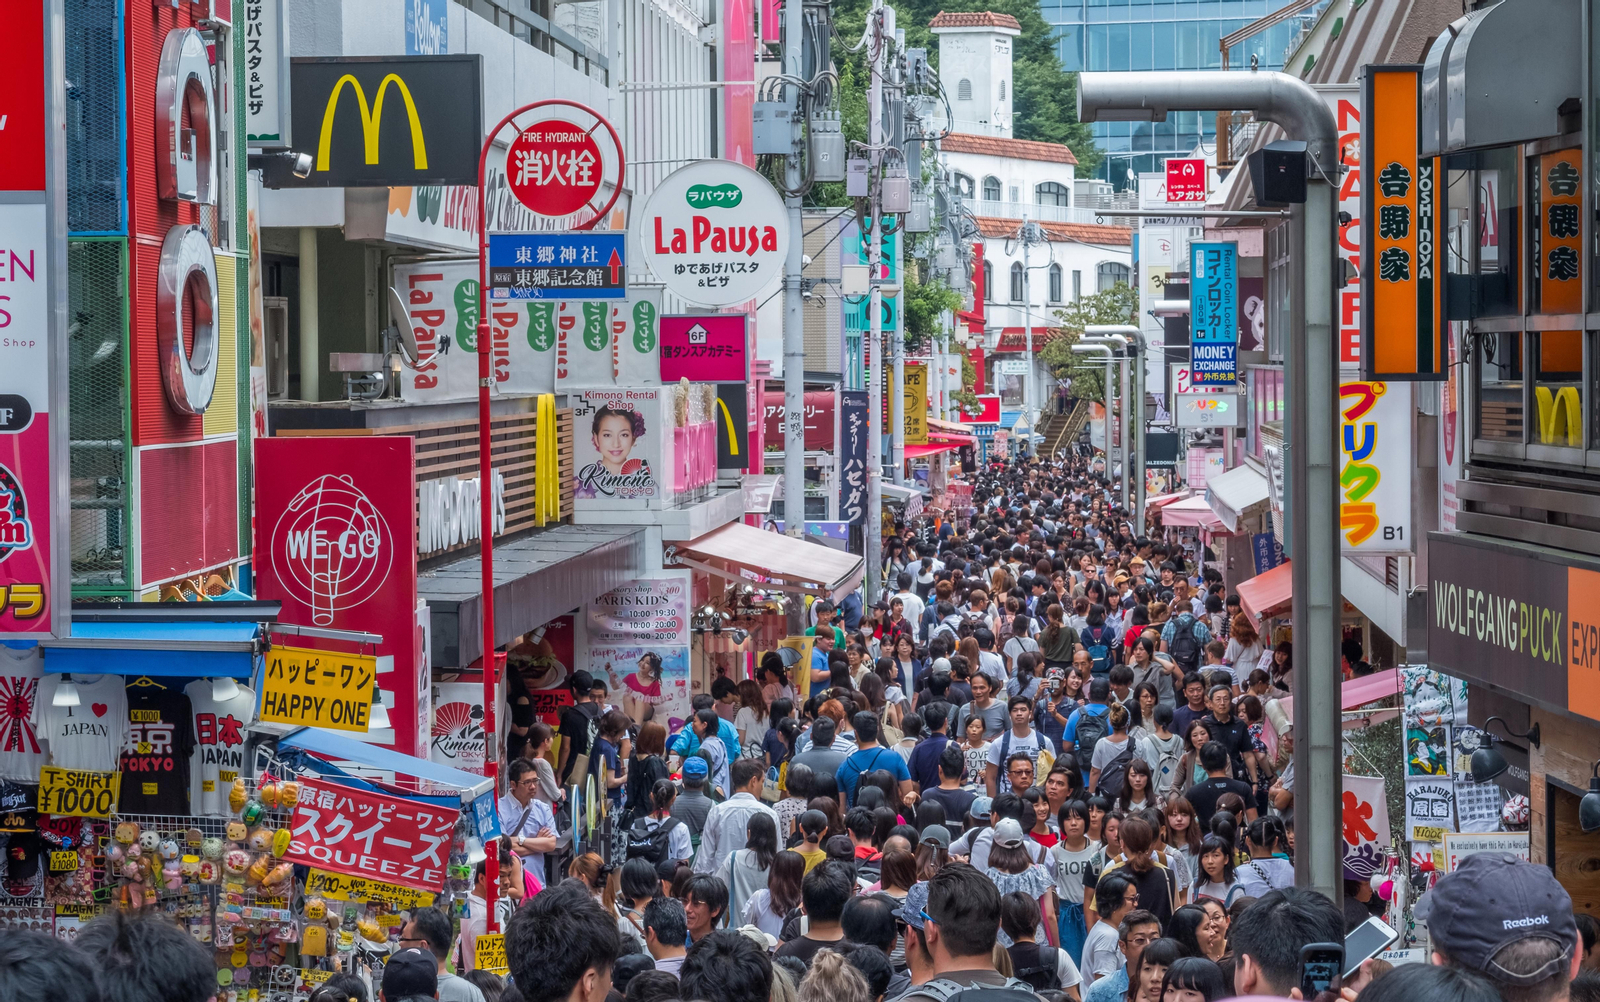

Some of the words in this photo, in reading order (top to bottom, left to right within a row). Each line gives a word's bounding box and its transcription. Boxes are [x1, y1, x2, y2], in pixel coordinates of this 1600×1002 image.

[522, 132, 542, 143] FIRE
[545, 132, 586, 143] HYDRANT
[514, 149, 596, 187] 消火栓
[1175, 191, 1205, 200] アガサ
[1418, 166, 1432, 279] YOSHINOYA
[654, 216, 687, 255] La
[692, 215, 778, 257] Pausa
[514, 245, 599, 264] 東郷神社
[674, 261, 760, 275] ゆであげパスタ
[1224, 249, 1232, 280] Rental
[514, 268, 604, 287] 東郷記念館
[697, 276, 730, 288] &ピザ
[1207, 249, 1222, 339] コインロッカー
[1224, 282, 1232, 304] Coin
[1224, 306, 1232, 339] Locker
[3, 338, 36, 348] Shop
[691, 331, 704, 341] 6F
[1193, 345, 1235, 359] MONEY
[1193, 361, 1235, 371] EXCHANGE
[584, 390, 623, 400] Kimono
[626, 390, 657, 400] Rental
[575, 408, 590, 416] 3F
[607, 400, 634, 411] Shop
[849, 411, 862, 456] ギャラリー
[1340, 381, 1387, 547] プリクラ
[578, 463, 655, 497] Kimono
[614, 487, 655, 496] TOKYO
[842, 458, 866, 522] ハセガワ
[1383, 525, 1403, 541] B1
[595, 595, 632, 606] PARIS
[635, 594, 669, 606] KID'S
[268, 658, 371, 691] ハッピーワン
[263, 691, 326, 721] HAPPY
[330, 698, 369, 727] ONE
[61, 722, 108, 738] JAPAN
[195, 712, 244, 748] 日本
[298, 787, 454, 833] 原宿ハッピーワン
[293, 808, 450, 868] スクイーズ
[286, 838, 443, 884] SQUEEZE
[1502, 914, 1550, 931] Reebok
